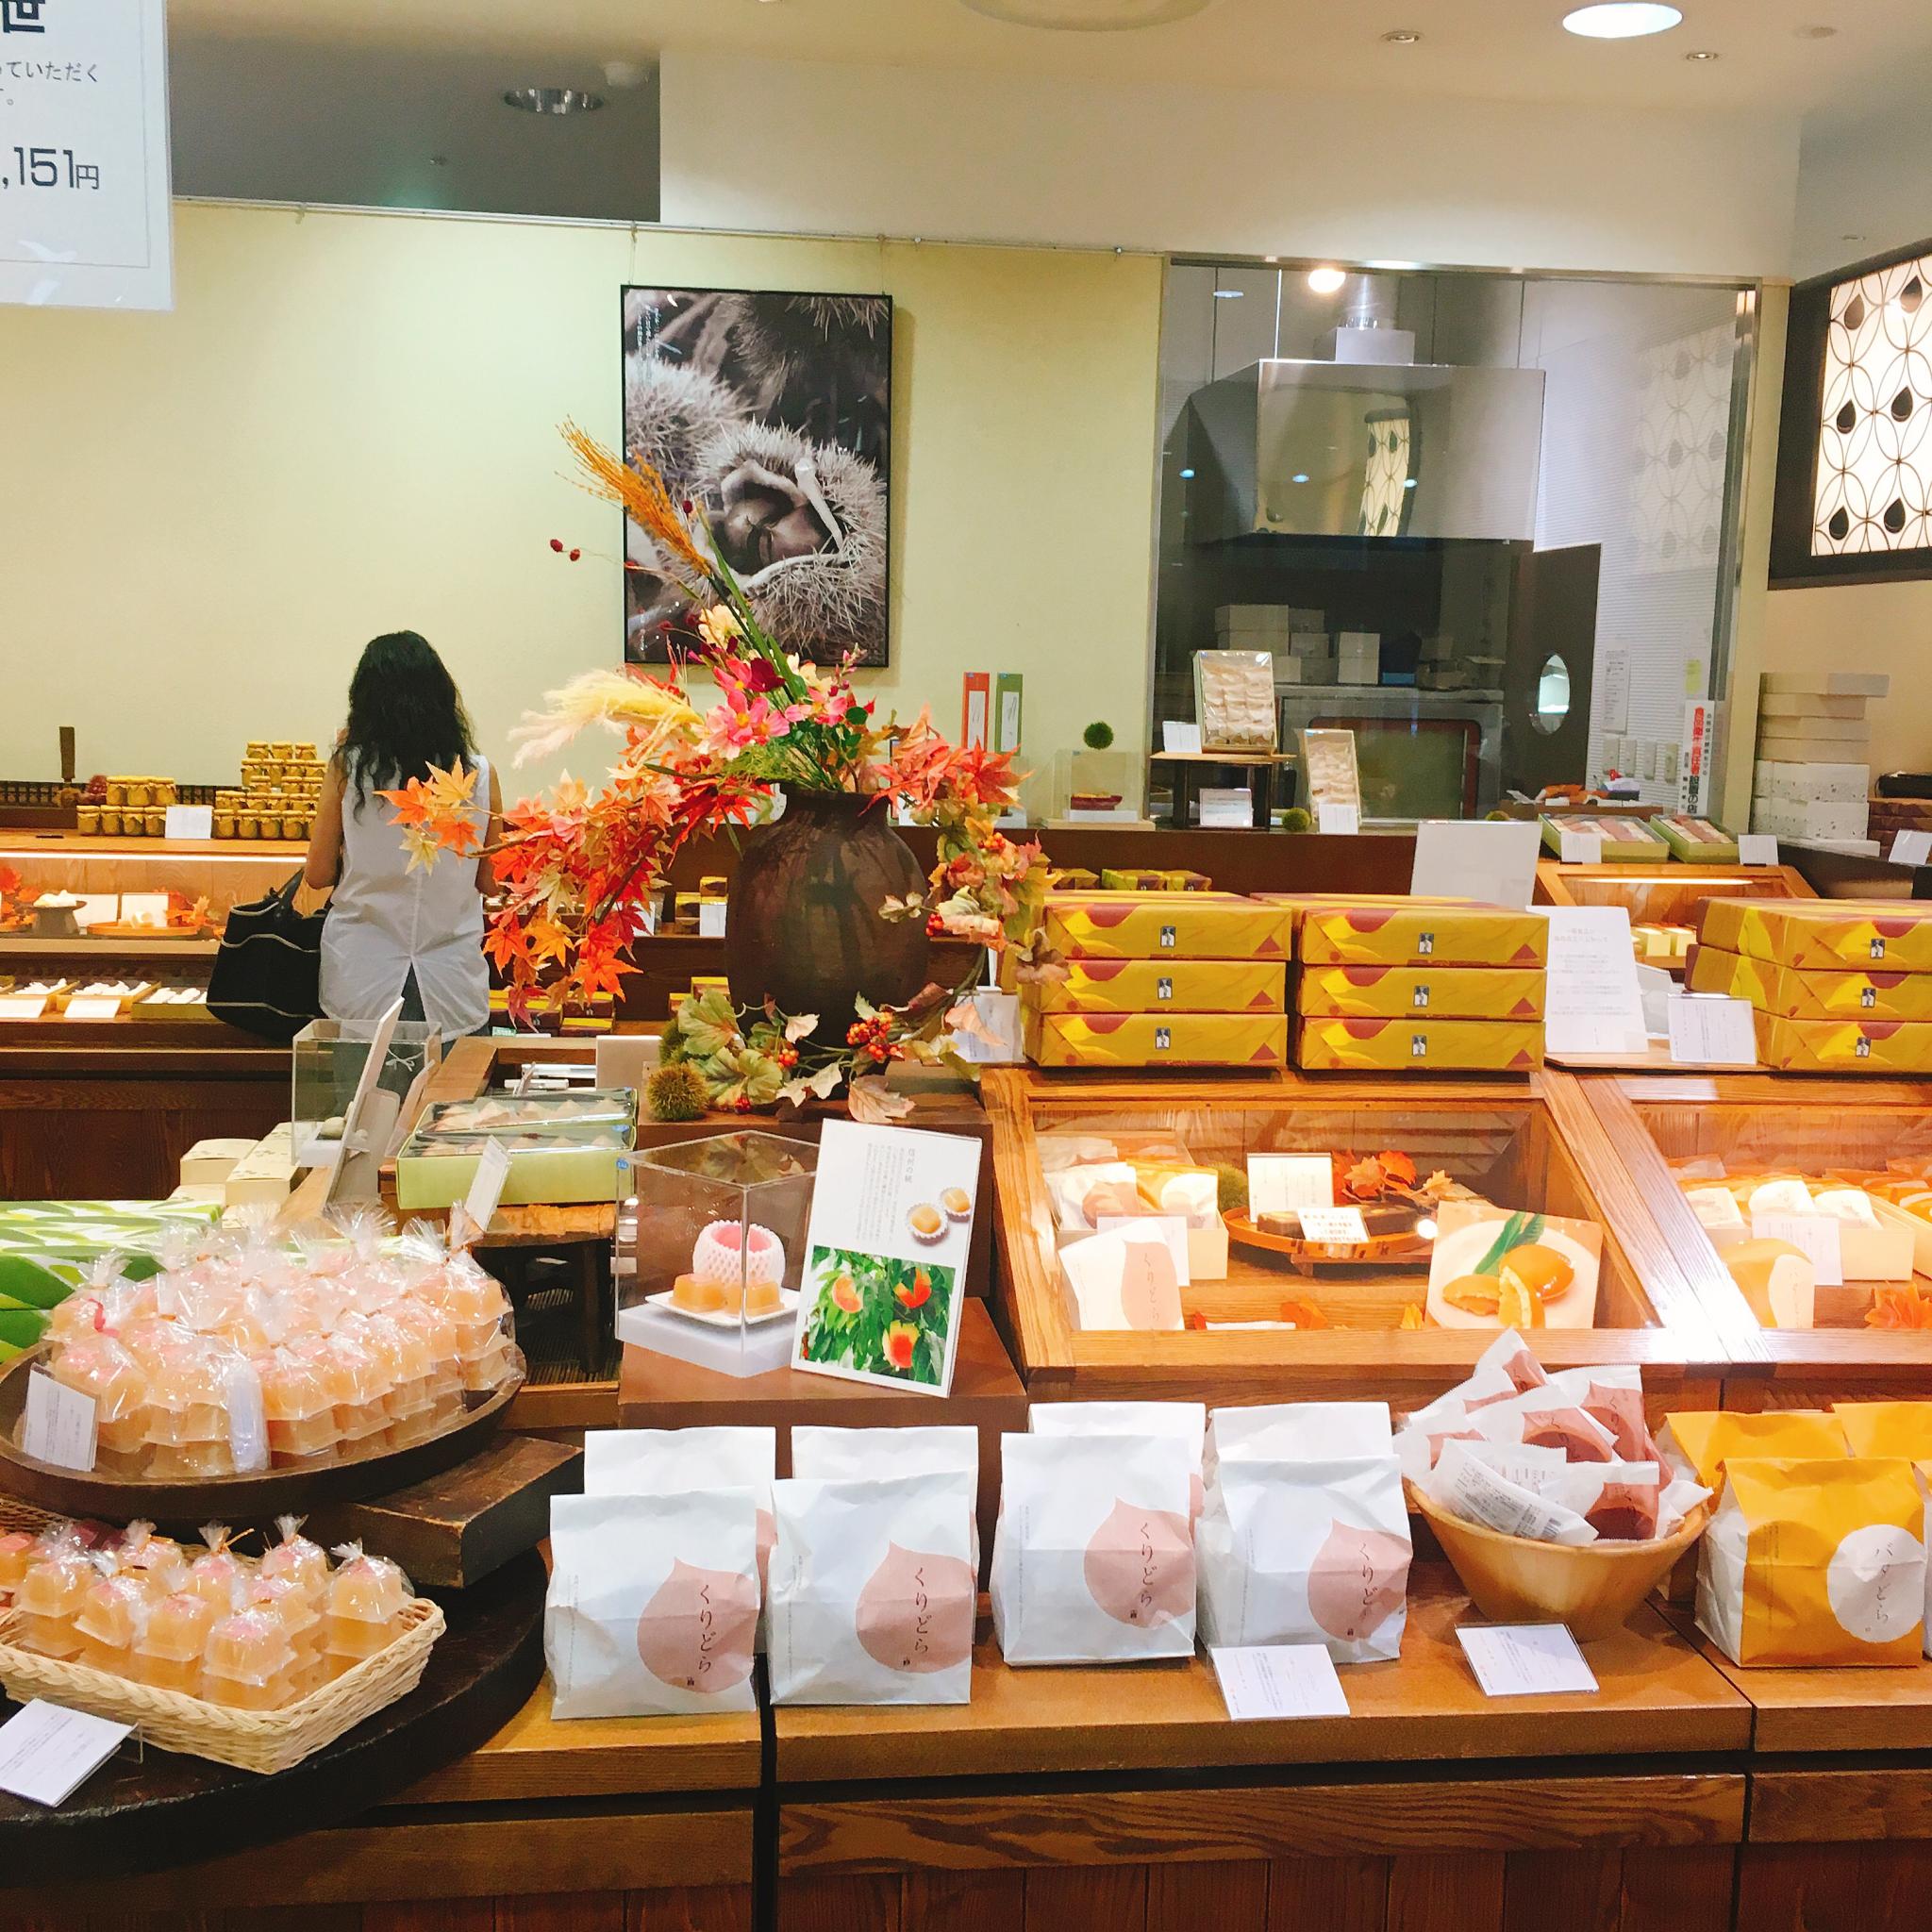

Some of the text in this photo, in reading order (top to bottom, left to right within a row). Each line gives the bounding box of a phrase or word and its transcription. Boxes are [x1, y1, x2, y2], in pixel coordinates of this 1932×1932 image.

[0, 61, 97, 82] ていただく
[1140, 1522, 1158, 1607] くりどら
[699, 1584, 717, 1674] くりどら
[913, 1567, 932, 1654] くりどら
